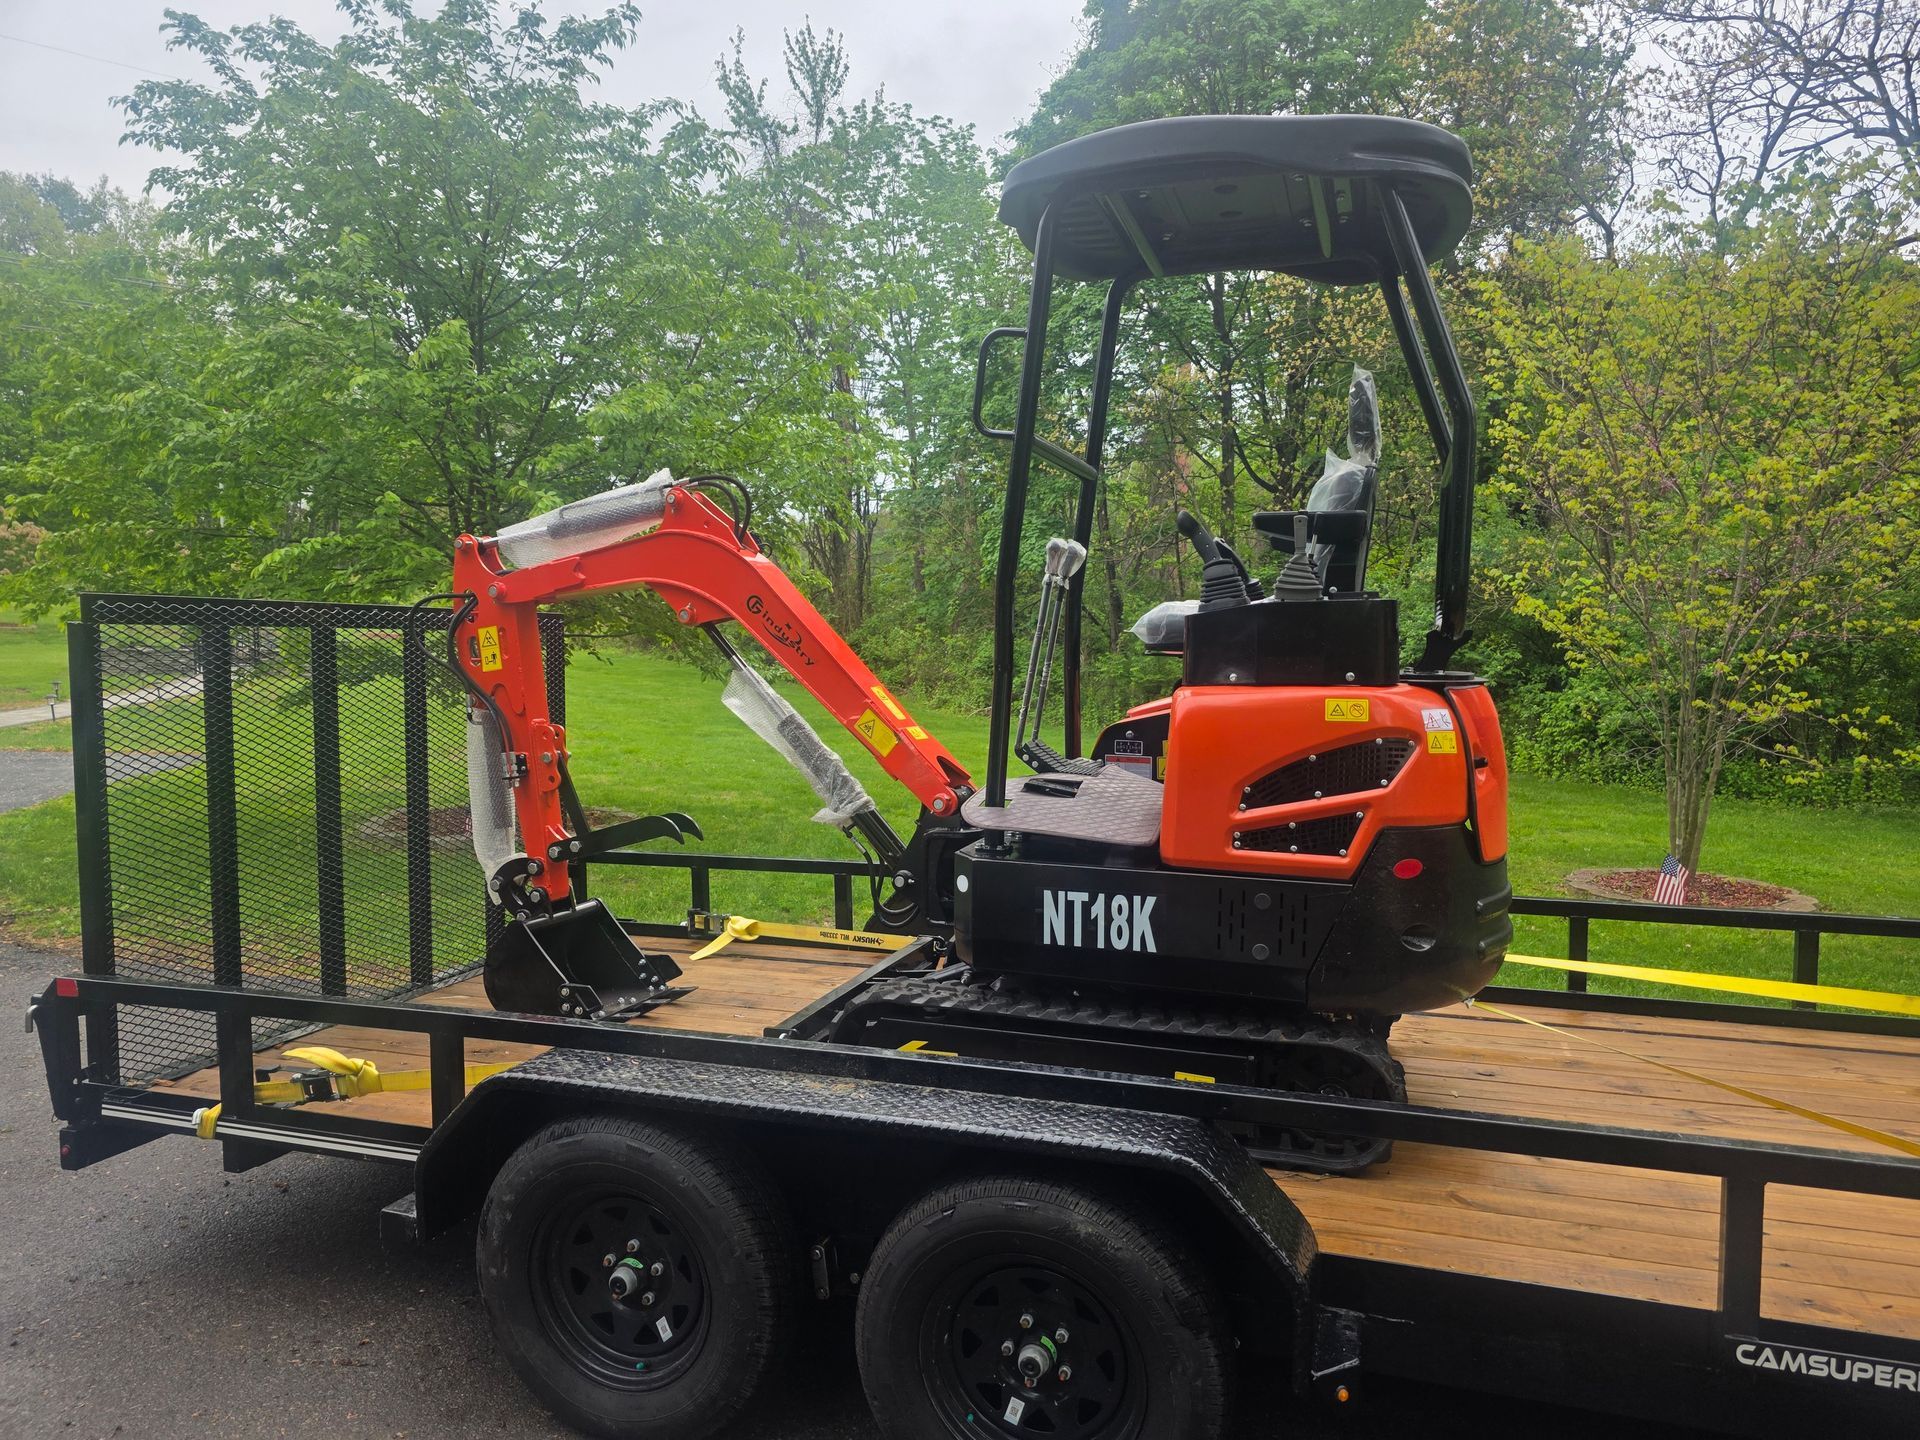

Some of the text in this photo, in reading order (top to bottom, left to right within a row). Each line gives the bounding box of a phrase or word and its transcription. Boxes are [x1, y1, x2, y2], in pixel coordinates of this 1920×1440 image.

[852, 935, 876, 945] HUSKY
[1043, 889, 1157, 953] NT18K
[1736, 1344, 1920, 1392] CAMSUPER
